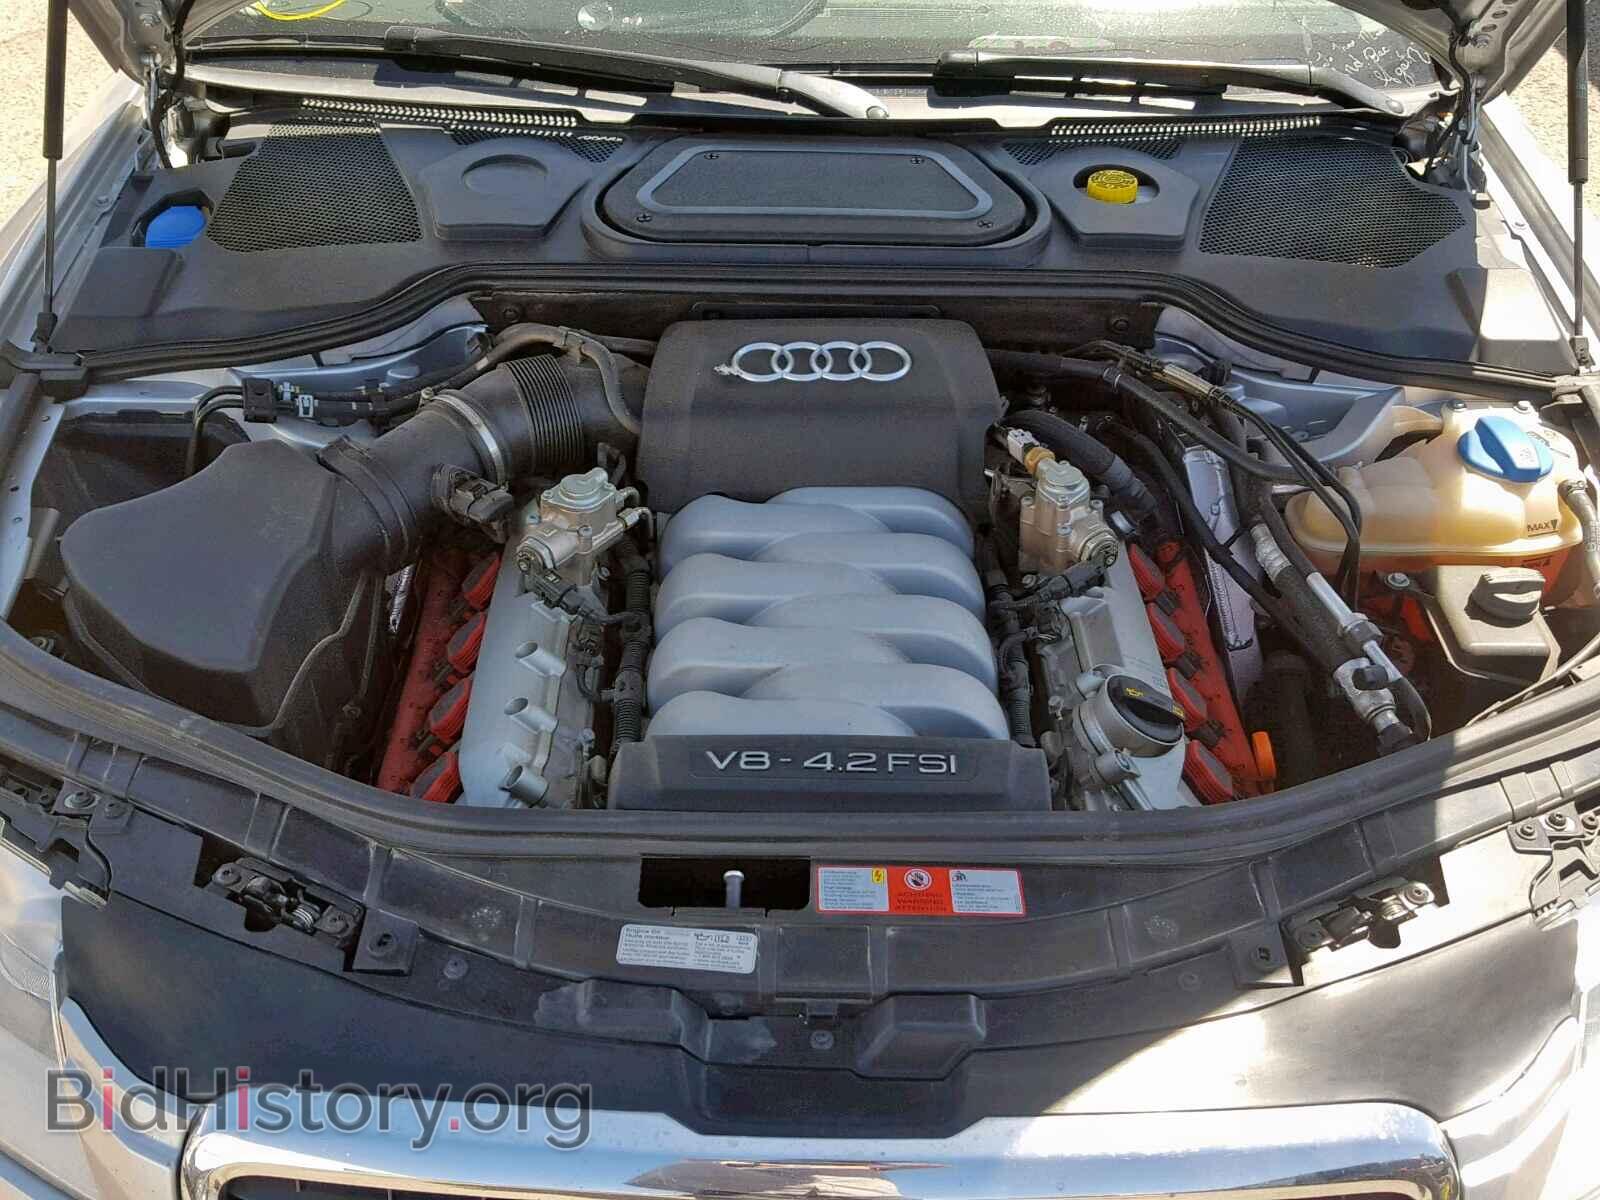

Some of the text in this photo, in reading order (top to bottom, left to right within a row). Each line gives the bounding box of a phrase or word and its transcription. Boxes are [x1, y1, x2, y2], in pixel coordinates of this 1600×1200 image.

[1527, 520, 1550, 532] MAX
[705, 751, 771, 771] V8
[802, 751, 878, 773] 4.2
[887, 752, 957, 774] FSI
